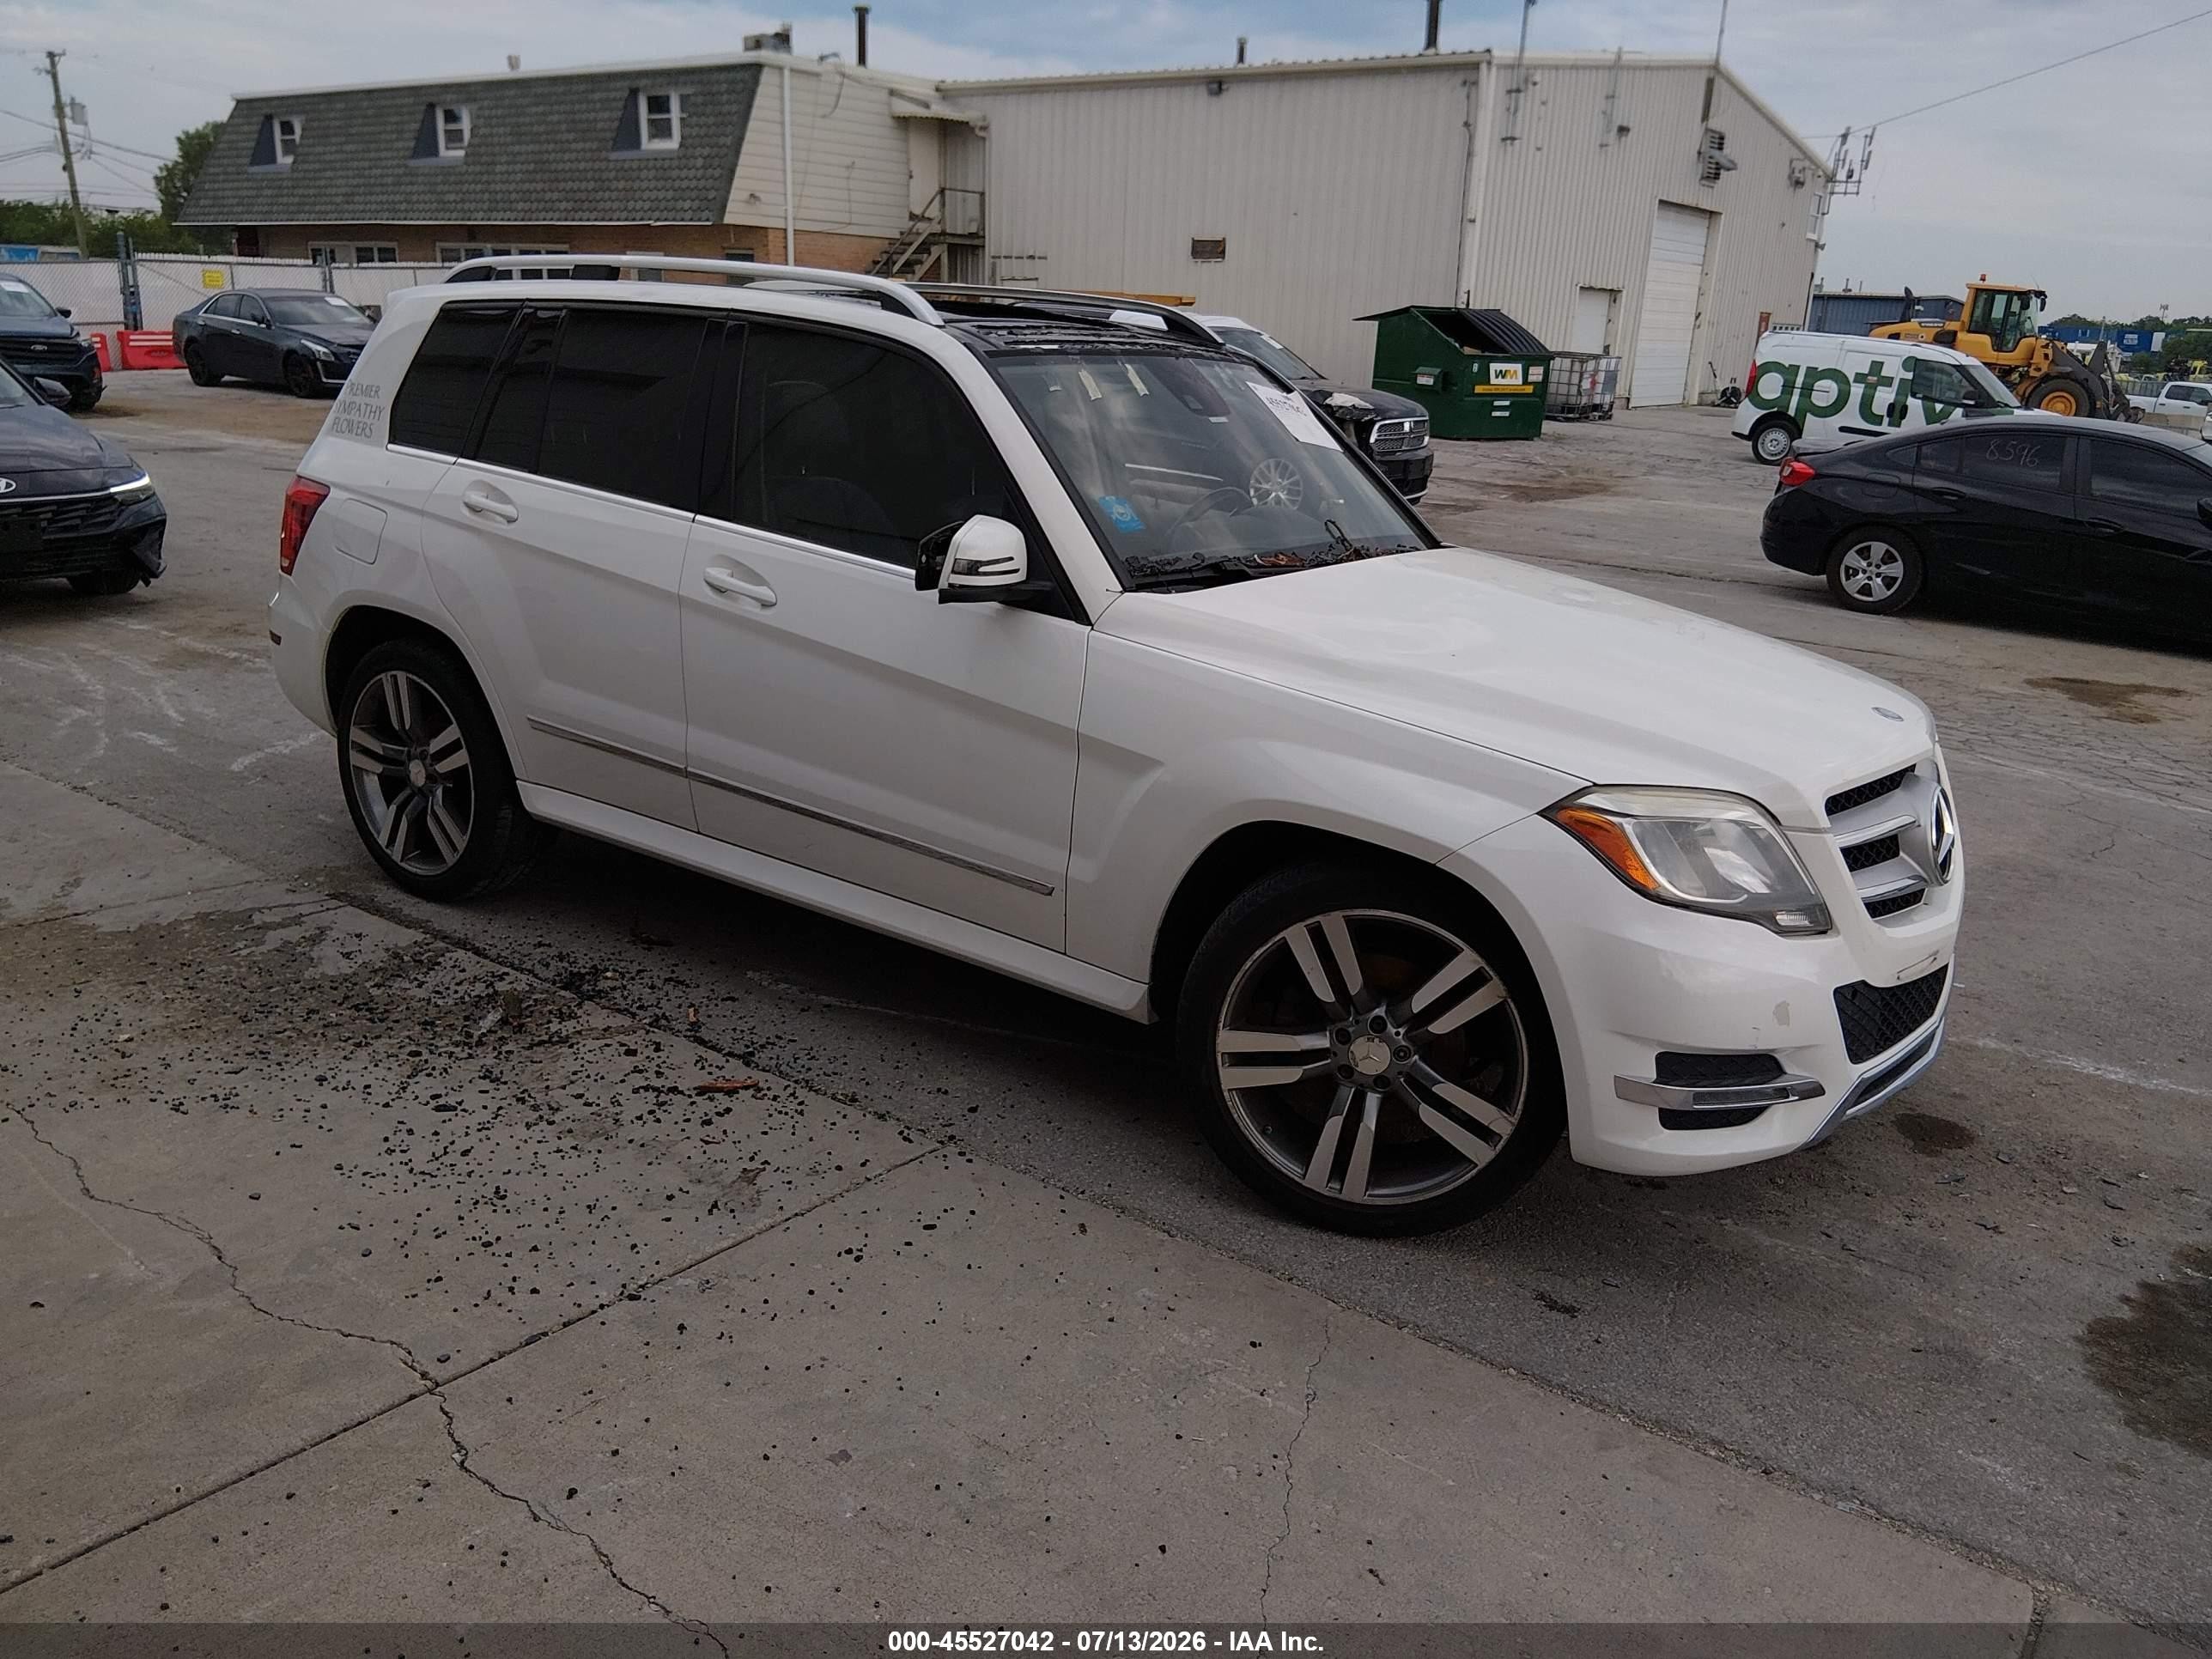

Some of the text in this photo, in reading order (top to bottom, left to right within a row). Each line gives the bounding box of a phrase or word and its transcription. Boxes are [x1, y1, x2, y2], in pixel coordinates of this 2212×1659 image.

[1494, 368, 1518, 380] WM
[345, 382, 380, 399] PREMIER
[334, 400, 385, 422] SYMPATHY
[332, 416, 374, 438] FLOWERS
[1986, 439, 2040, 468] 8596
